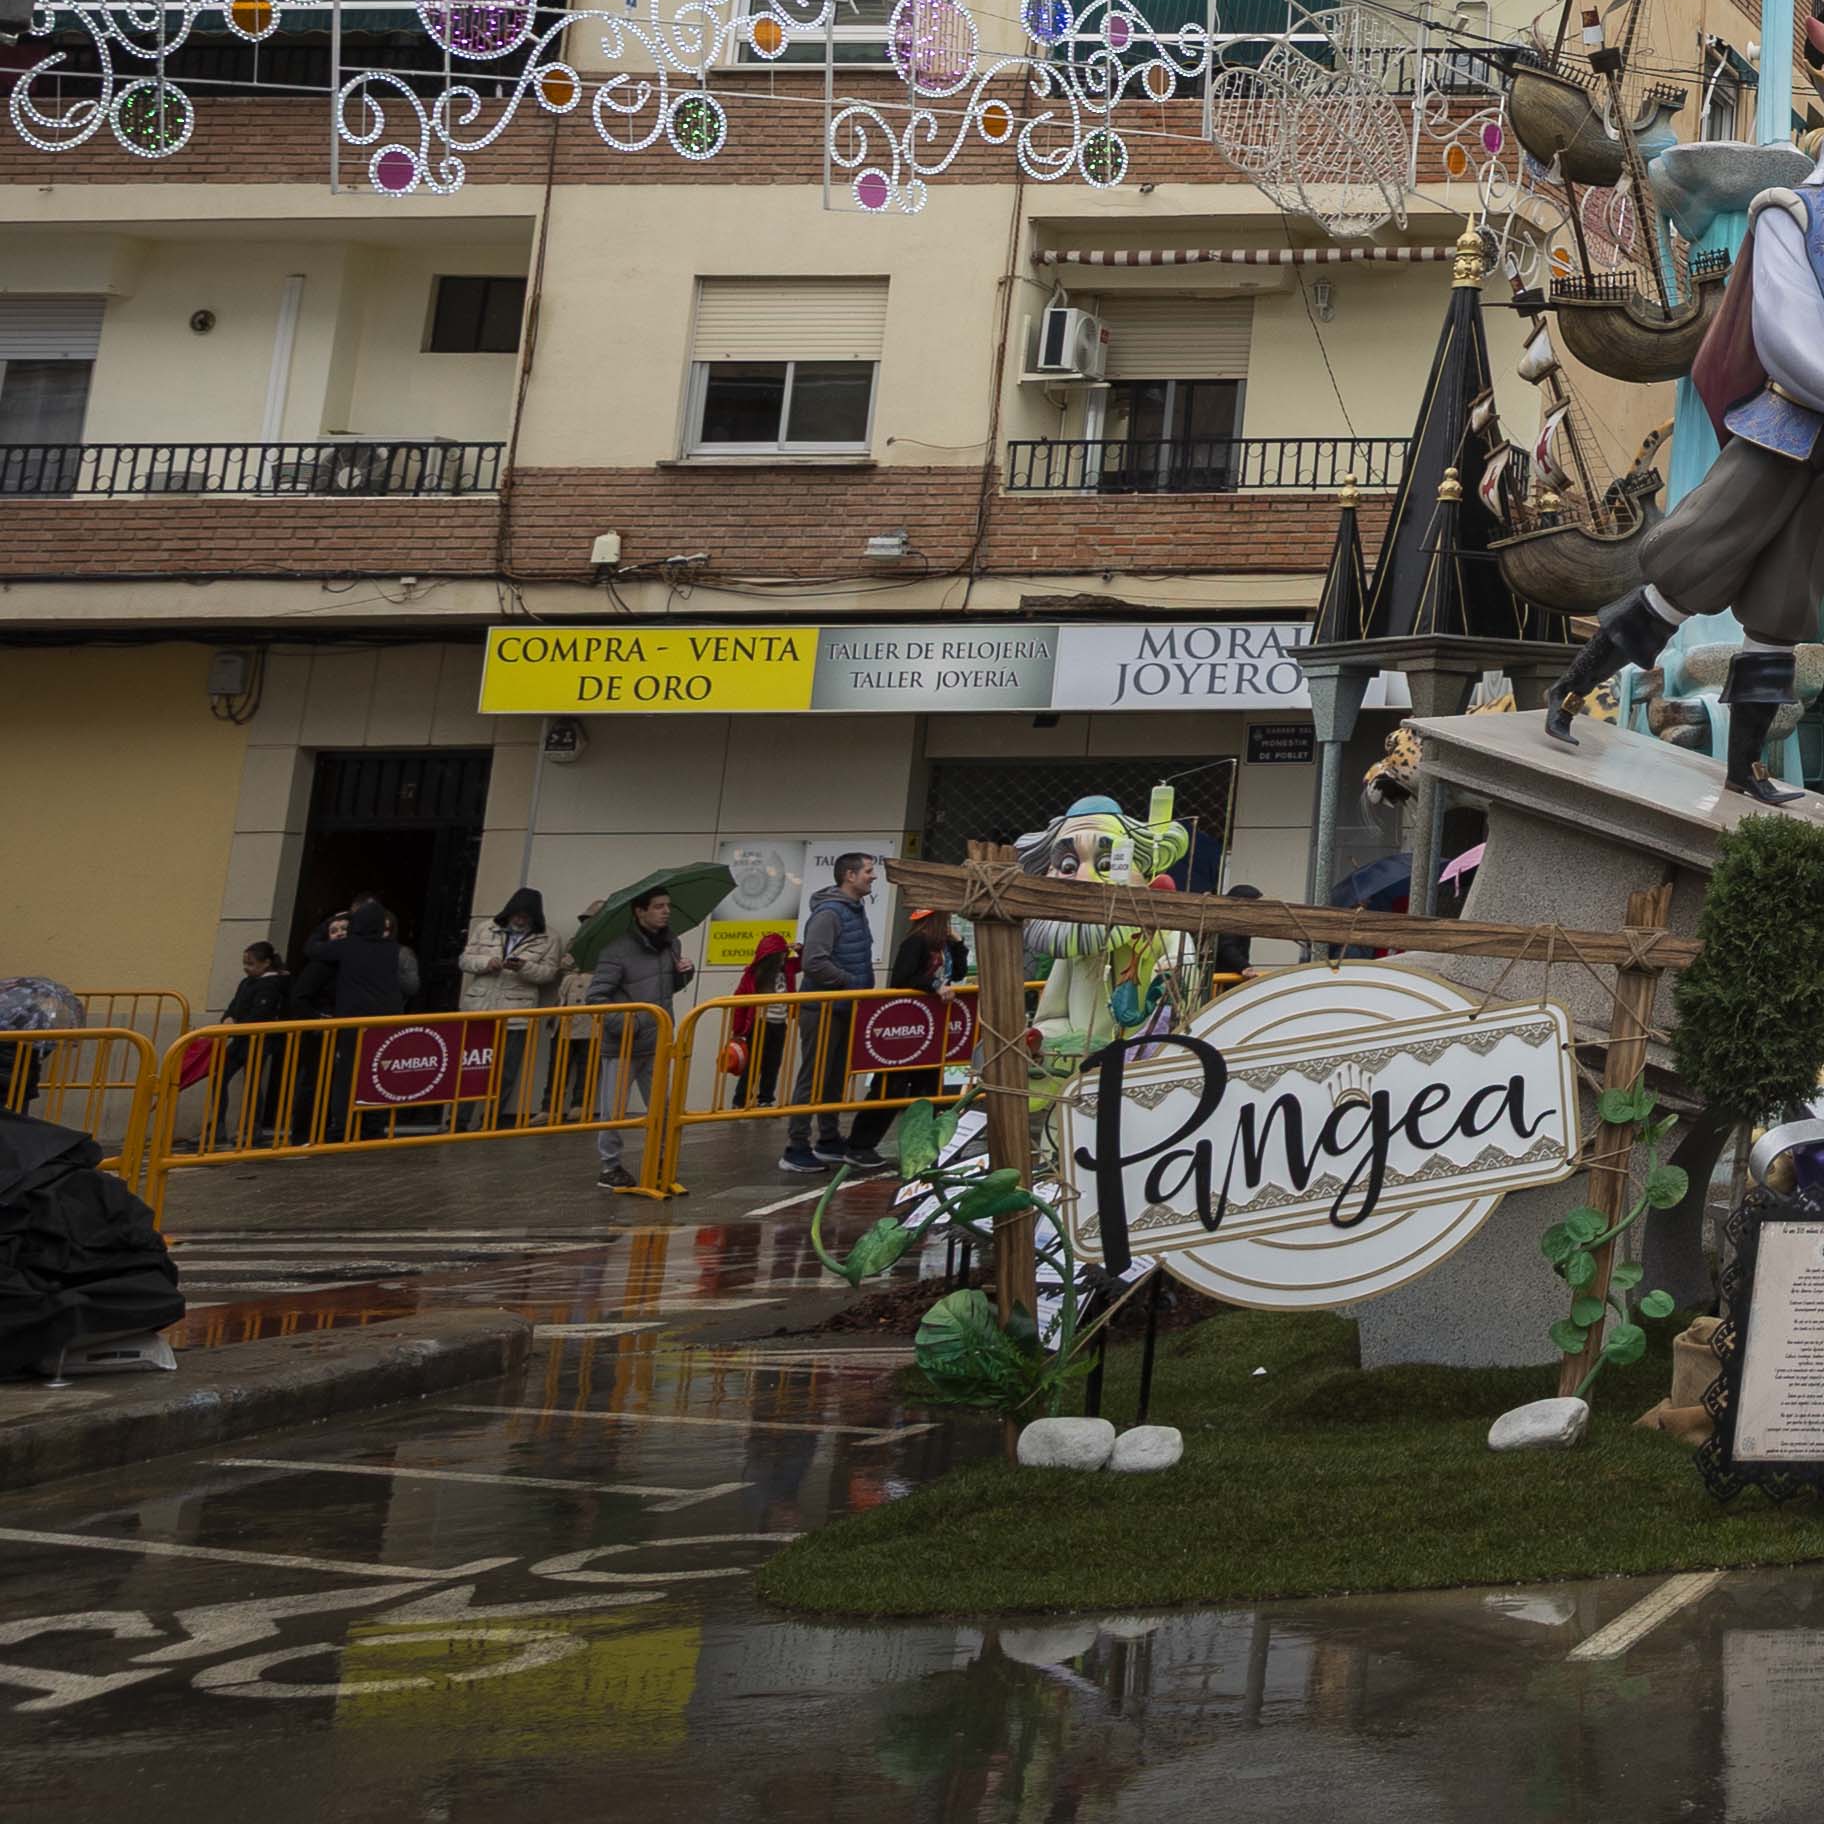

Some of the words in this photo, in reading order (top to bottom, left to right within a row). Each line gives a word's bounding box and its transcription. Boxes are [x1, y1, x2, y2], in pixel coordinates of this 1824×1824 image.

[496, 636, 646, 663] COMPRA
[688, 637, 801, 663] VENTA
[827, 642, 901, 661] TALLER
[906, 642, 936, 661] DE
[942, 637, 1050, 662] RELOJERÍA
[577, 675, 622, 701] DE
[633, 674, 713, 701] ORO
[850, 671, 924, 689] TALLER
[934, 666, 1021, 690] JOYERÍA
[1112, 661, 1311, 706] JOYERO
[881, 1025, 925, 1039] AMBAR
[390, 1056, 438, 1071] AMBAR
[1074, 1035, 1557, 1278] Pangea
